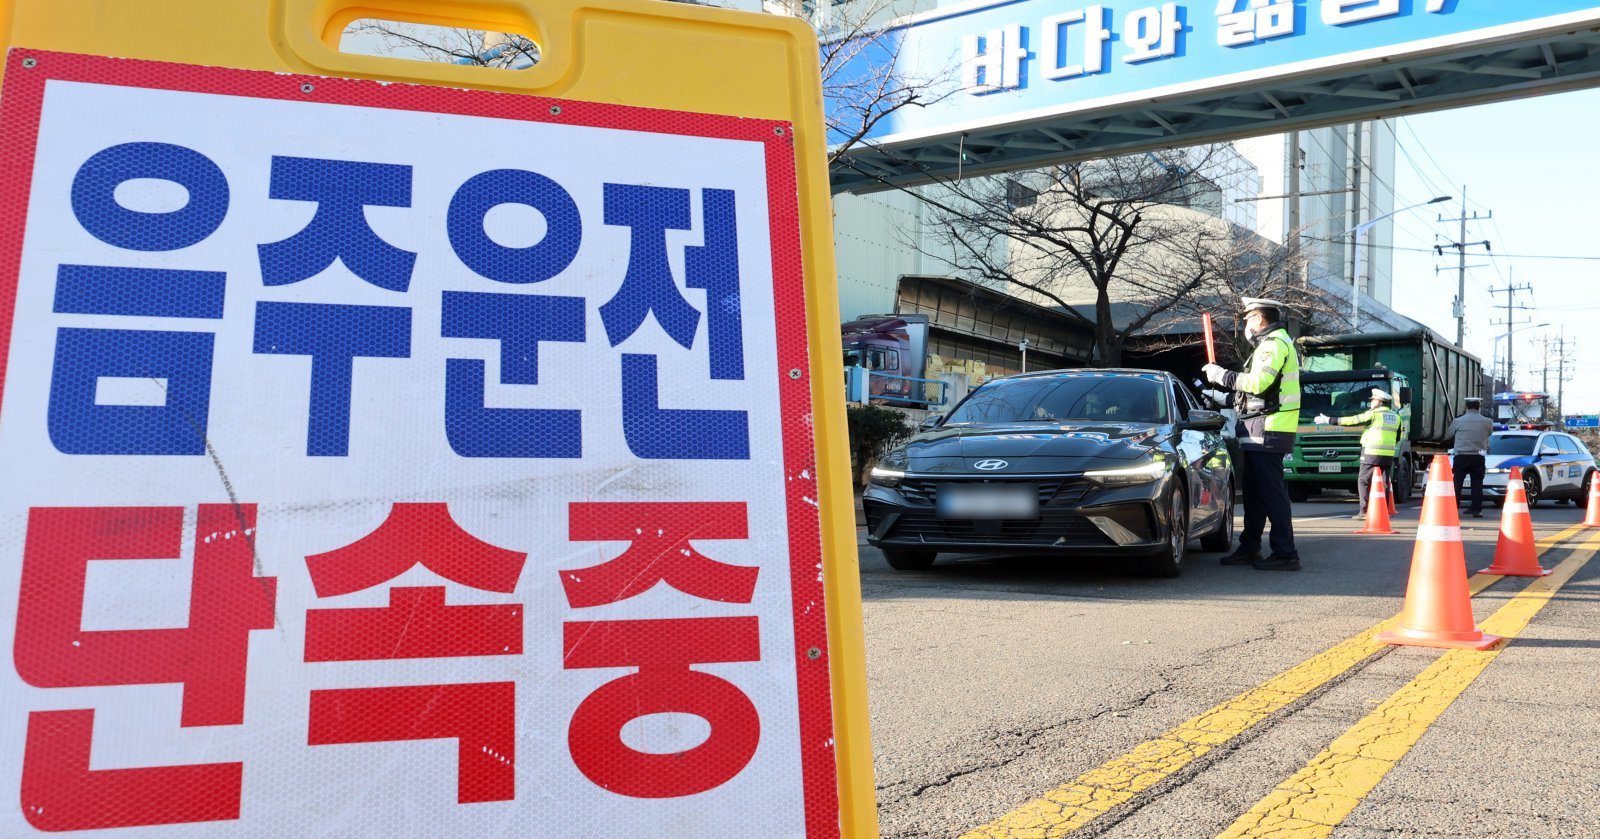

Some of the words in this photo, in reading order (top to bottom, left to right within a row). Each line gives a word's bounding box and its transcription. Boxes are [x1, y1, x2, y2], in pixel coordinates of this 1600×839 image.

[961, 2, 1184, 95] 바다와
[48, 142, 750, 459] 음주운전
[15, 503, 761, 831] 단속중
